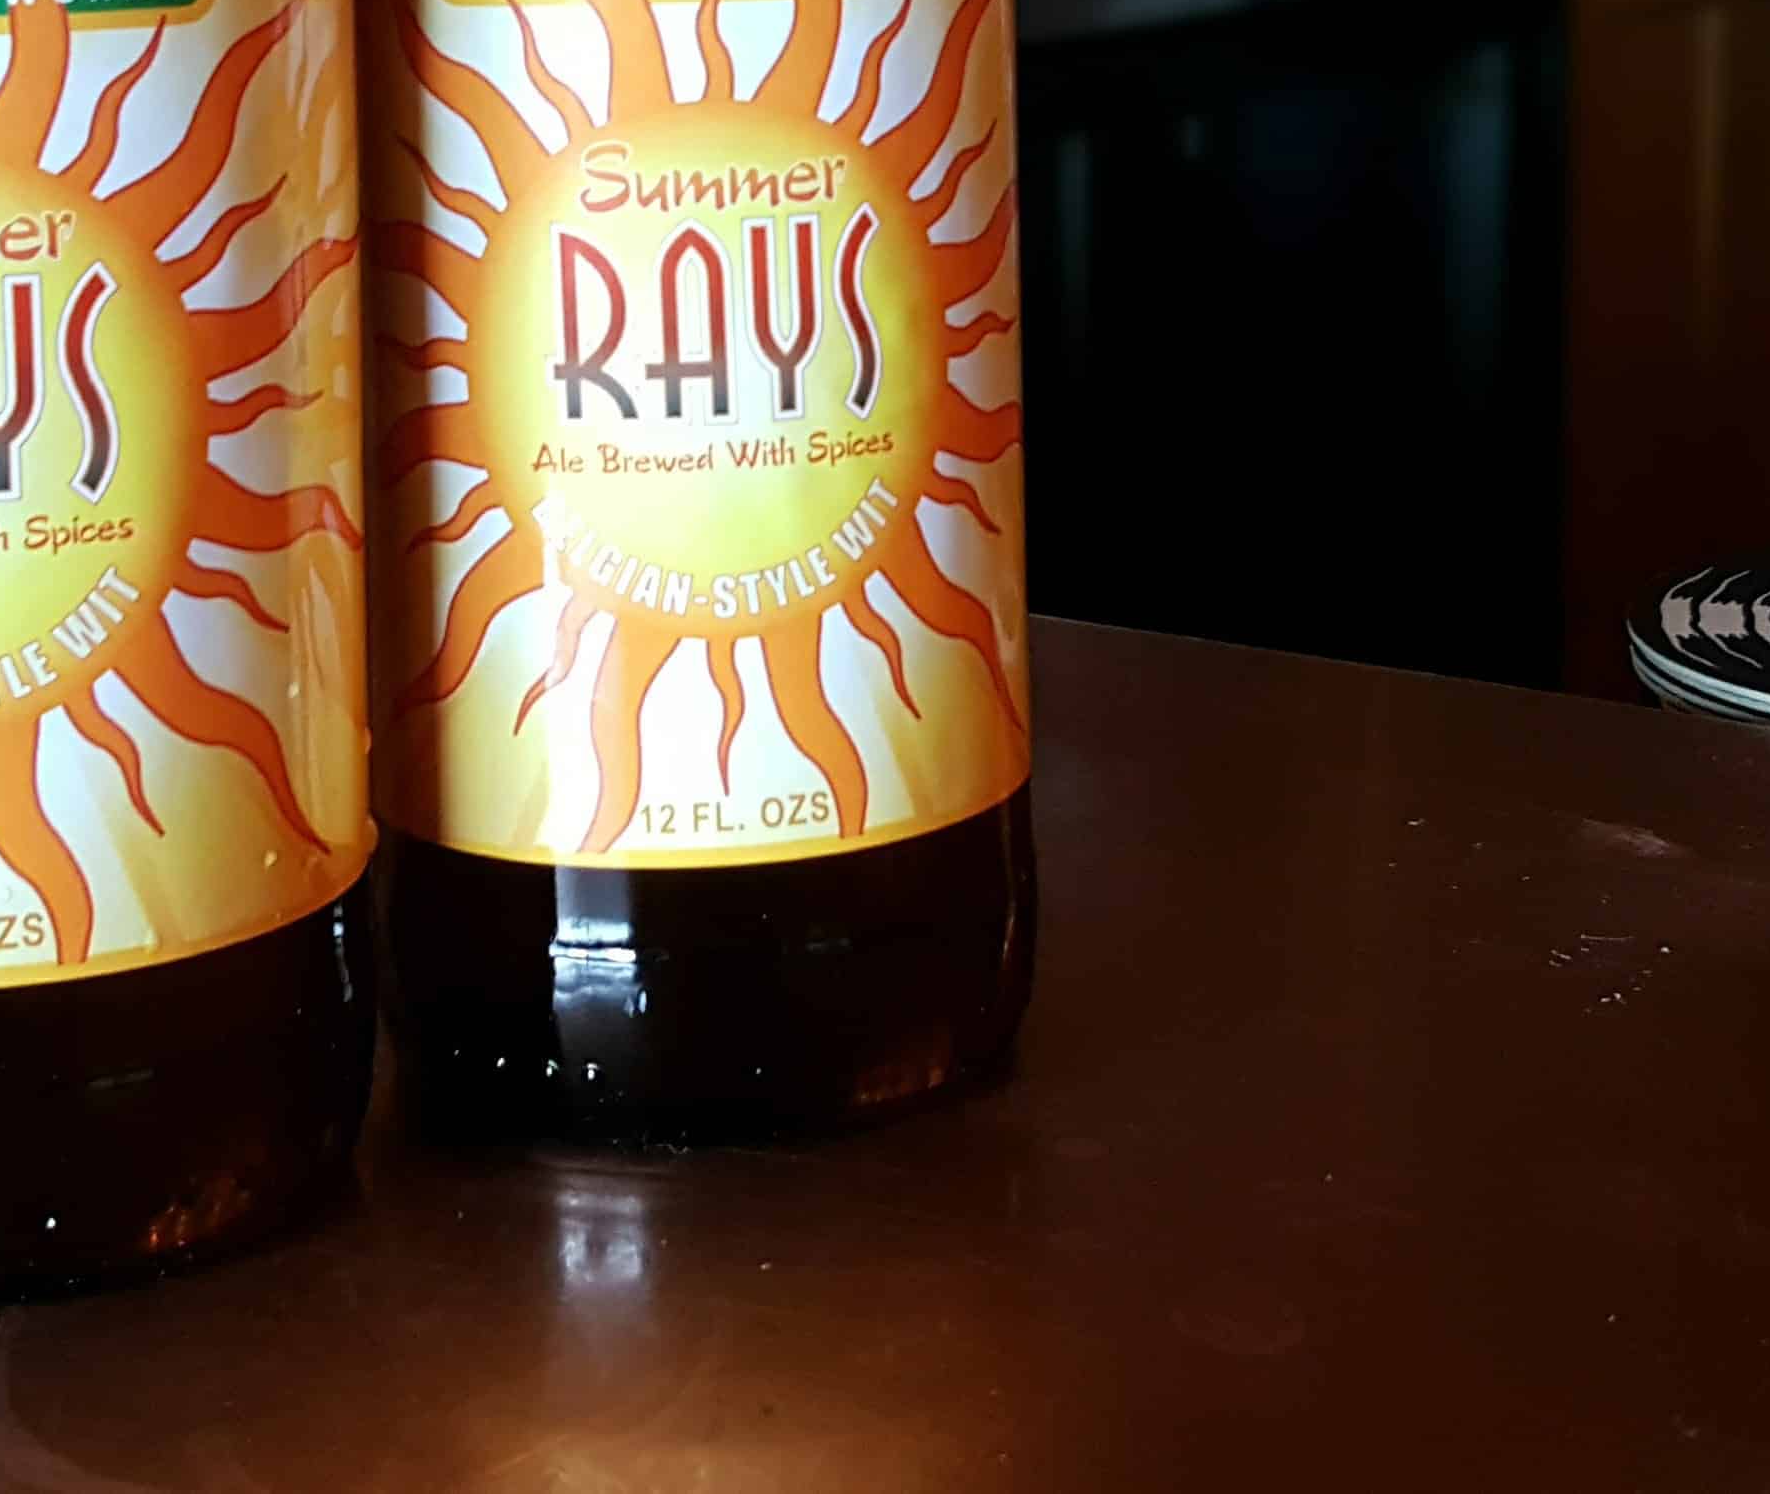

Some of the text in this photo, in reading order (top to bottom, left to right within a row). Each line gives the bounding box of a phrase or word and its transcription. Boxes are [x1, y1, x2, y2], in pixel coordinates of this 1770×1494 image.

[579, 142, 847, 212] Summer
[549, 206, 881, 421] RAYS
[532, 430, 895, 474] Ale Brewed With Spices
[23, 513, 136, 555] Spices
[532, 475, 900, 618] LGIAN-STYLE WIT
[51, 564, 141, 660] WIT
[640, 790, 831, 834] 12 FL. OZS
